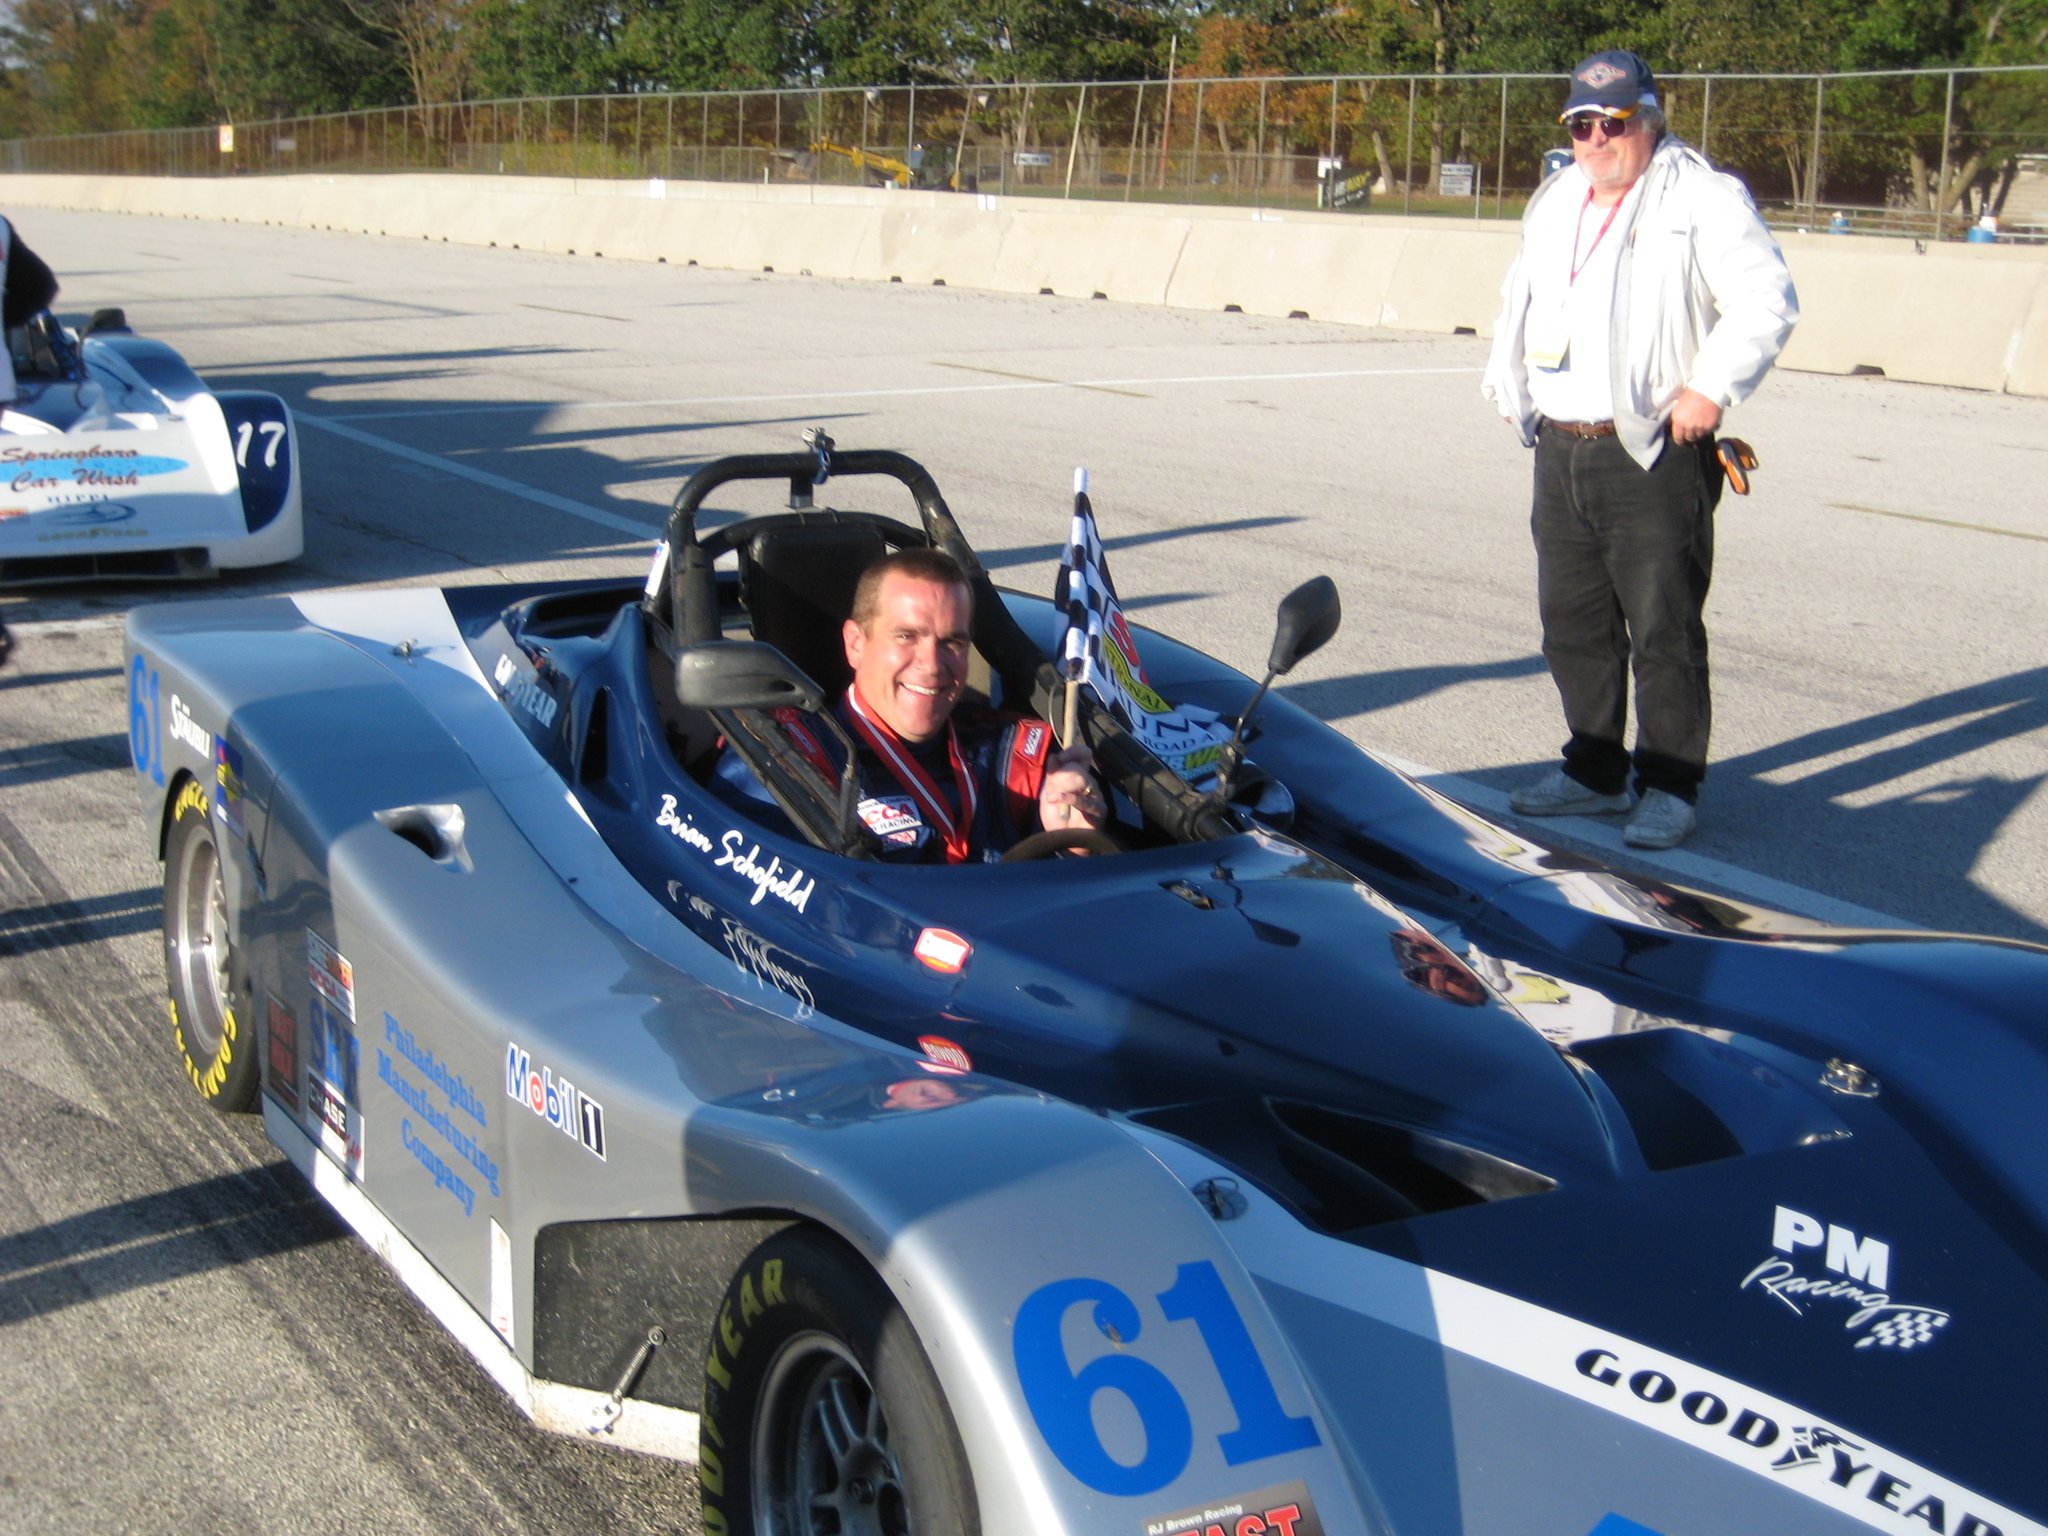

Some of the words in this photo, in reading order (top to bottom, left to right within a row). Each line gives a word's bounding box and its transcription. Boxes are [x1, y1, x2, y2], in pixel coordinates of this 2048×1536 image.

[0, 445, 138, 465] Springboro
[11, 471, 58, 492] Car
[72, 468, 138, 485] Wash
[236, 421, 286, 469] 17
[130, 654, 165, 788] 61
[656, 793, 713, 853] Brian
[714, 830, 816, 914] Schofield
[384, 1010, 487, 1128] Philadelphia
[506, 1042, 578, 1140] Mobil
[376, 1047, 500, 1198] Manufacturing
[402, 1117, 475, 1217] Company
[1740, 1256, 1892, 1329] Racing
[1772, 1204, 1890, 1291] PM
[1012, 1259, 1323, 1497] 61
[1167, 1512, 1203, 1531] Brown
[1204, 1503, 1243, 1521] Racing
